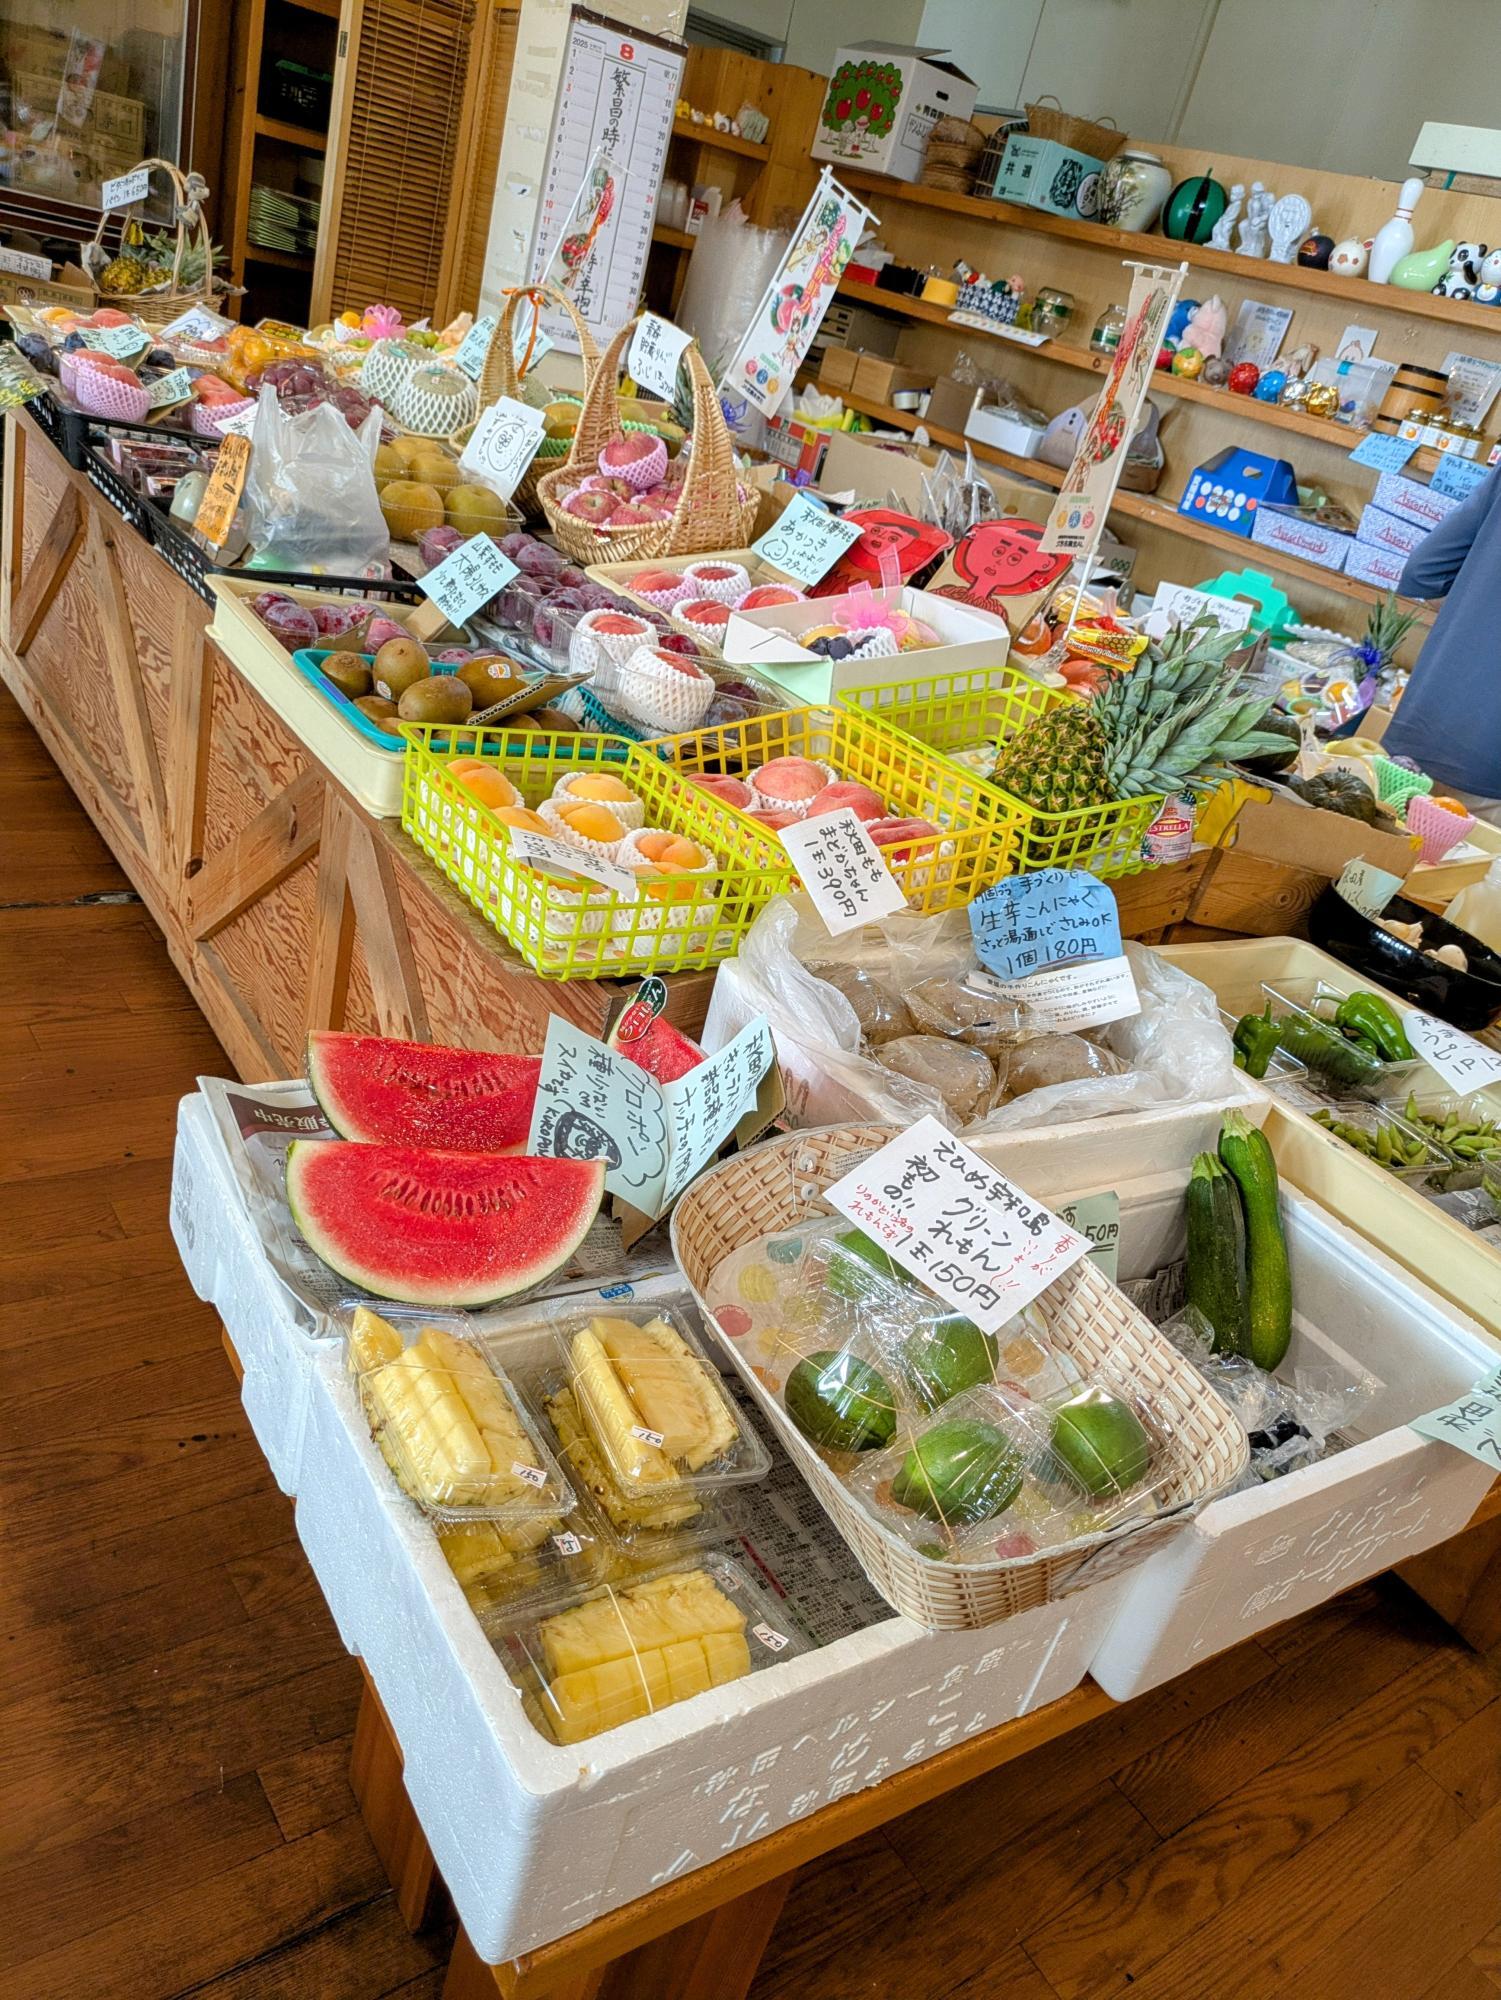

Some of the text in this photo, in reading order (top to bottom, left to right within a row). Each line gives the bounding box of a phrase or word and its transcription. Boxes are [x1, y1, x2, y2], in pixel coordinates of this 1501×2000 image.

[619, 42, 635, 61] 8
[780, 519, 828, 551] あかつき
[819, 827, 870, 904] まどかちゃん
[838, 819, 883, 884] 秋田もも
[933, 1140, 1051, 1237] えひめ宇和島
[928, 1219, 1002, 1273] れもん
[942, 1196, 1013, 1249] グリーン
